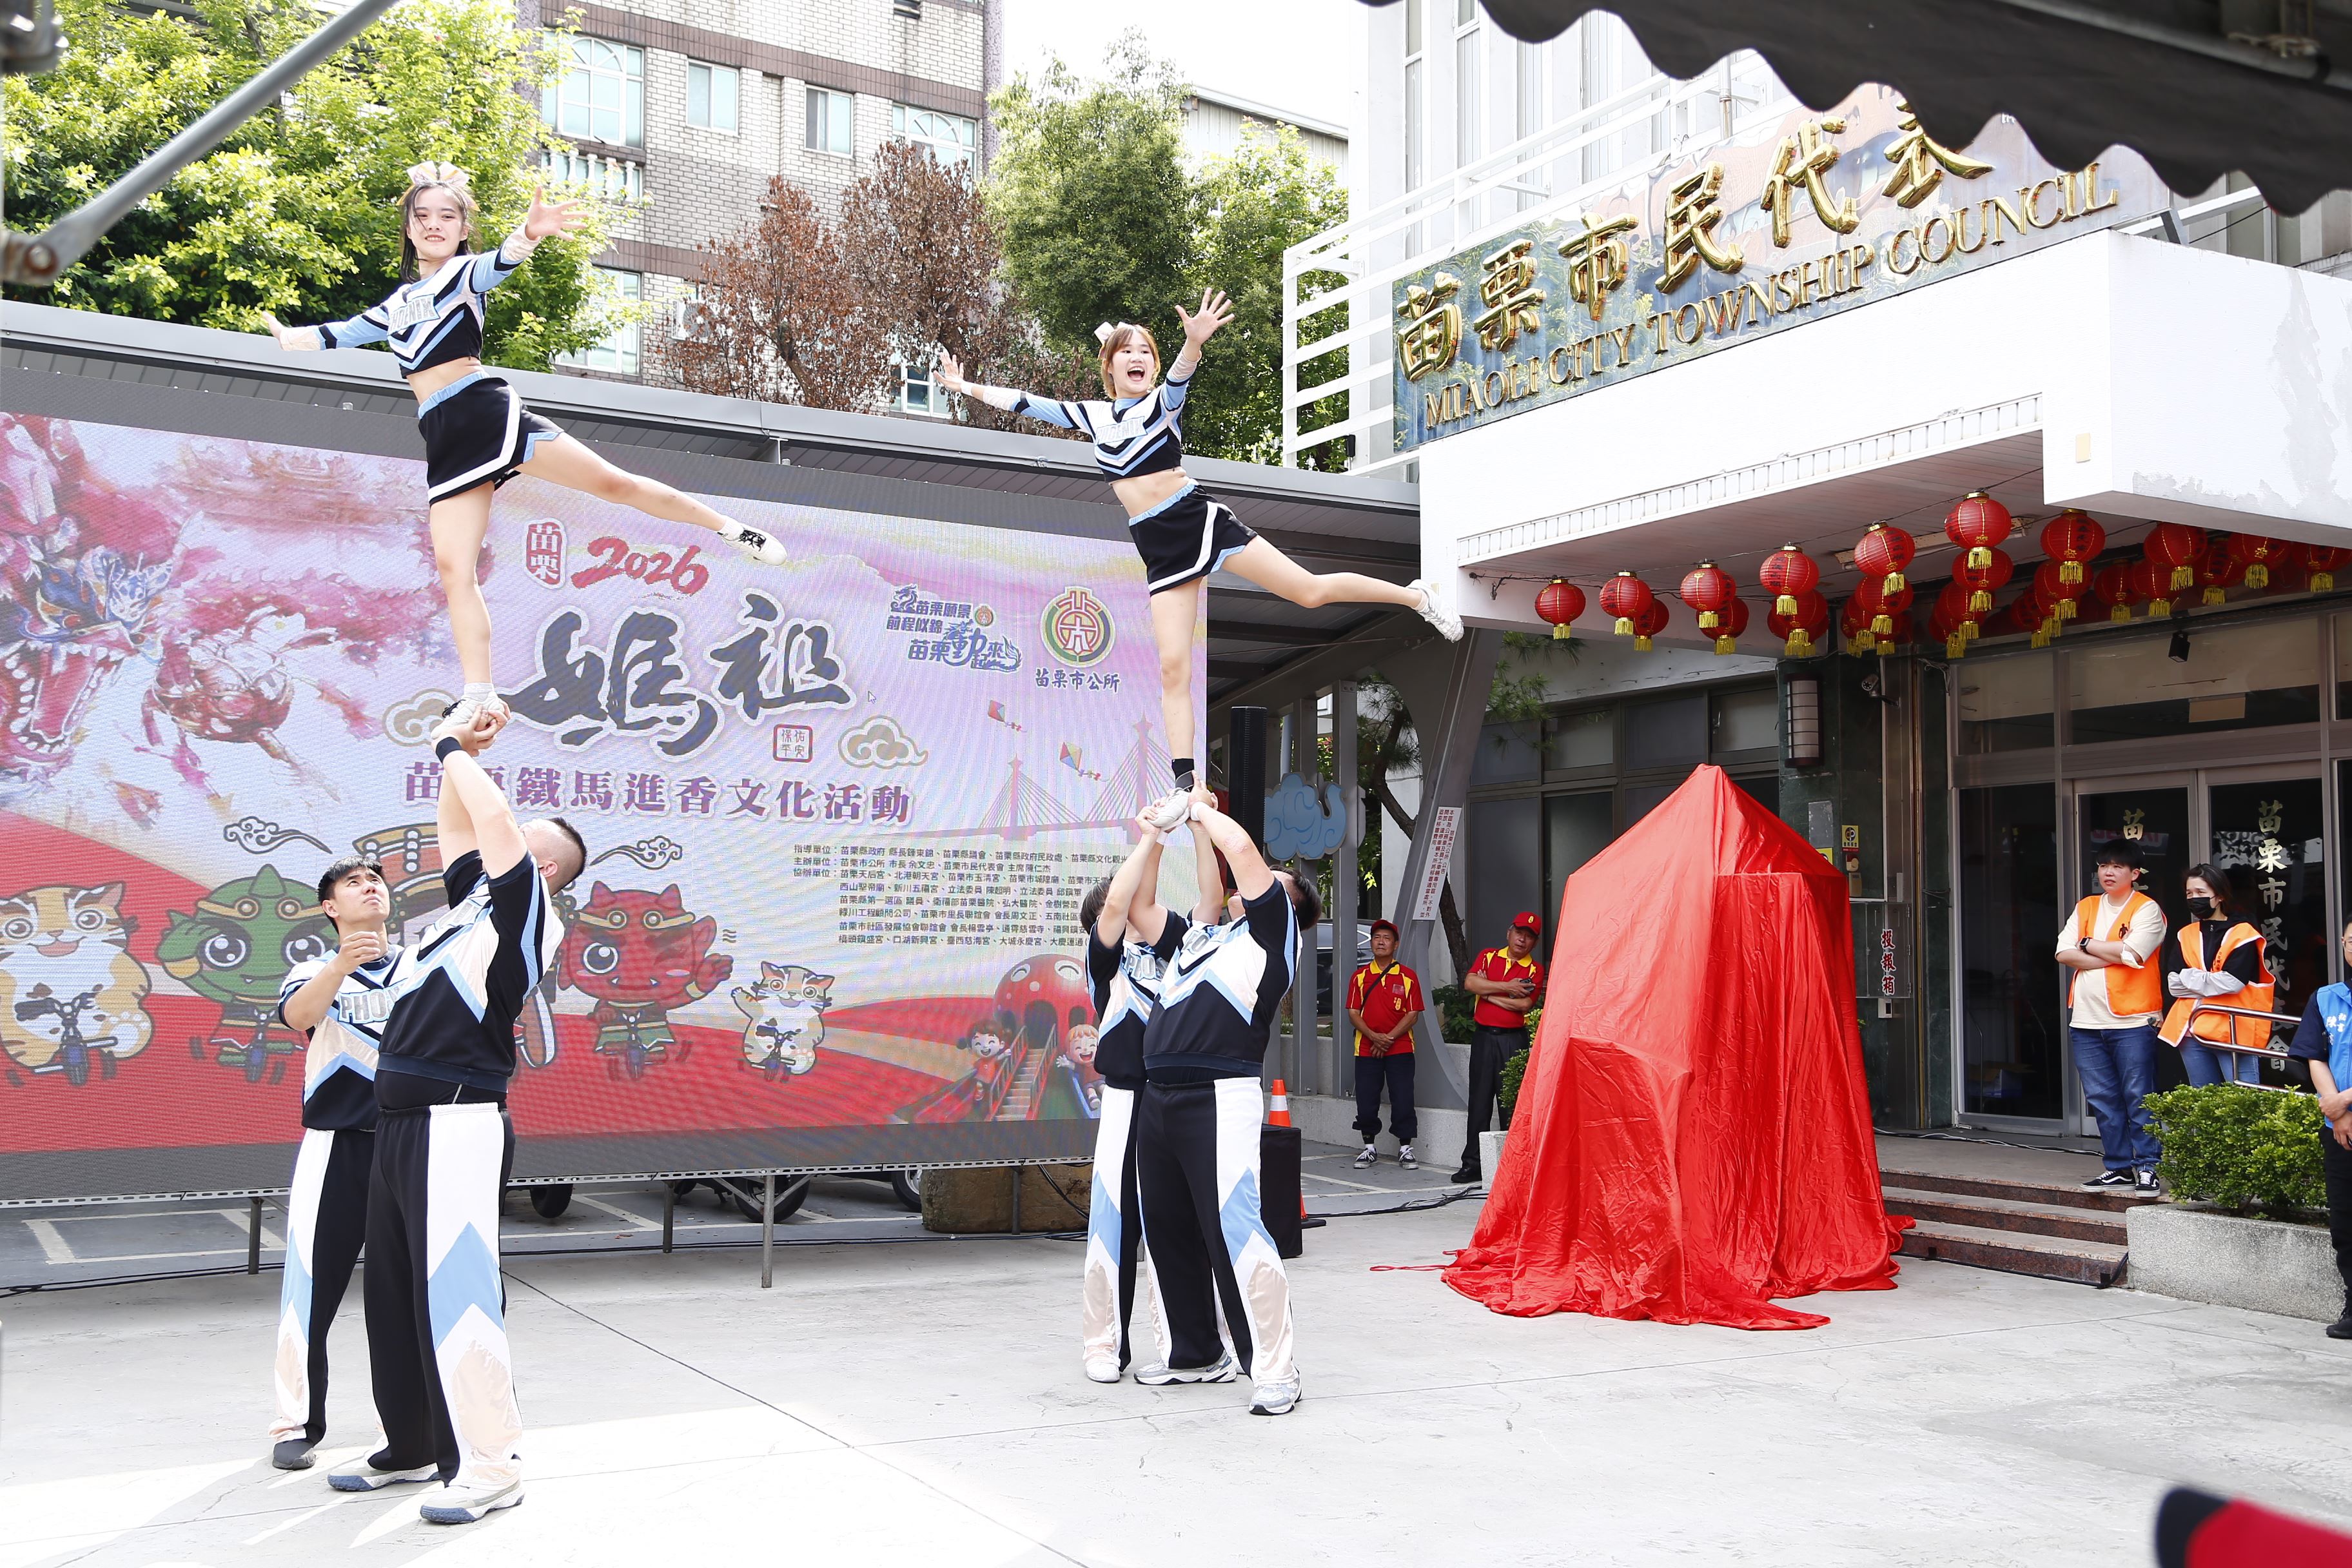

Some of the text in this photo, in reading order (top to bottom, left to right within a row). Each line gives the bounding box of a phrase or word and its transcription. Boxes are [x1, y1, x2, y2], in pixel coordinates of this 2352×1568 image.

[1424, 162, 2119, 429] MIAOLI CITY TOWNSHIP COUNCIL
[528, 524, 560, 580] 苗栗
[571, 536, 709, 594] 2026
[887, 614, 943, 634] 前程似錦
[916, 600, 972, 618] 苗栗願景
[498, 594, 850, 756] 媽祖
[1035, 669, 1121, 692] 苗栗市公所
[1881, 929, 1896, 995] 投報箱
